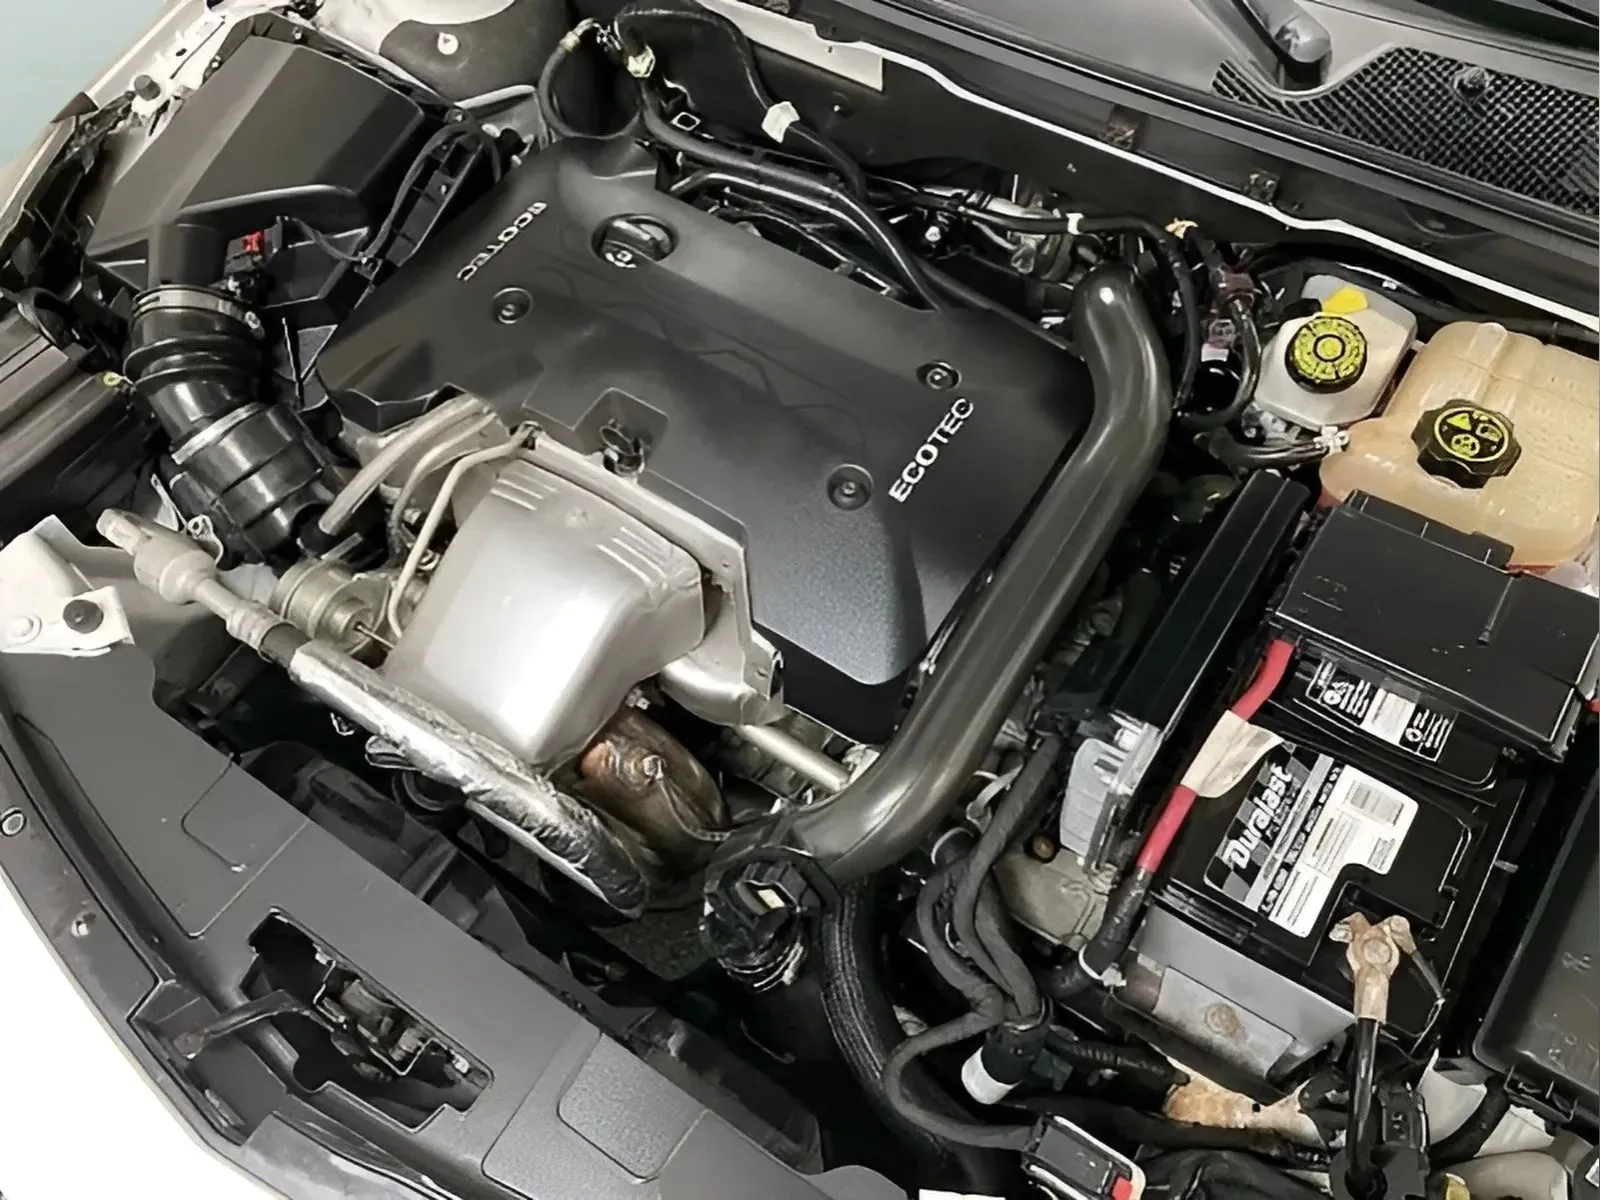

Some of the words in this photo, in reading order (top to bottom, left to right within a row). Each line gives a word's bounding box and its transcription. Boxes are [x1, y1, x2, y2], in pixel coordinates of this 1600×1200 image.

[457, 202, 547, 281] ECOTEC
[888, 398, 974, 502] ECOTEC
[1224, 764, 1293, 870] Duralast
